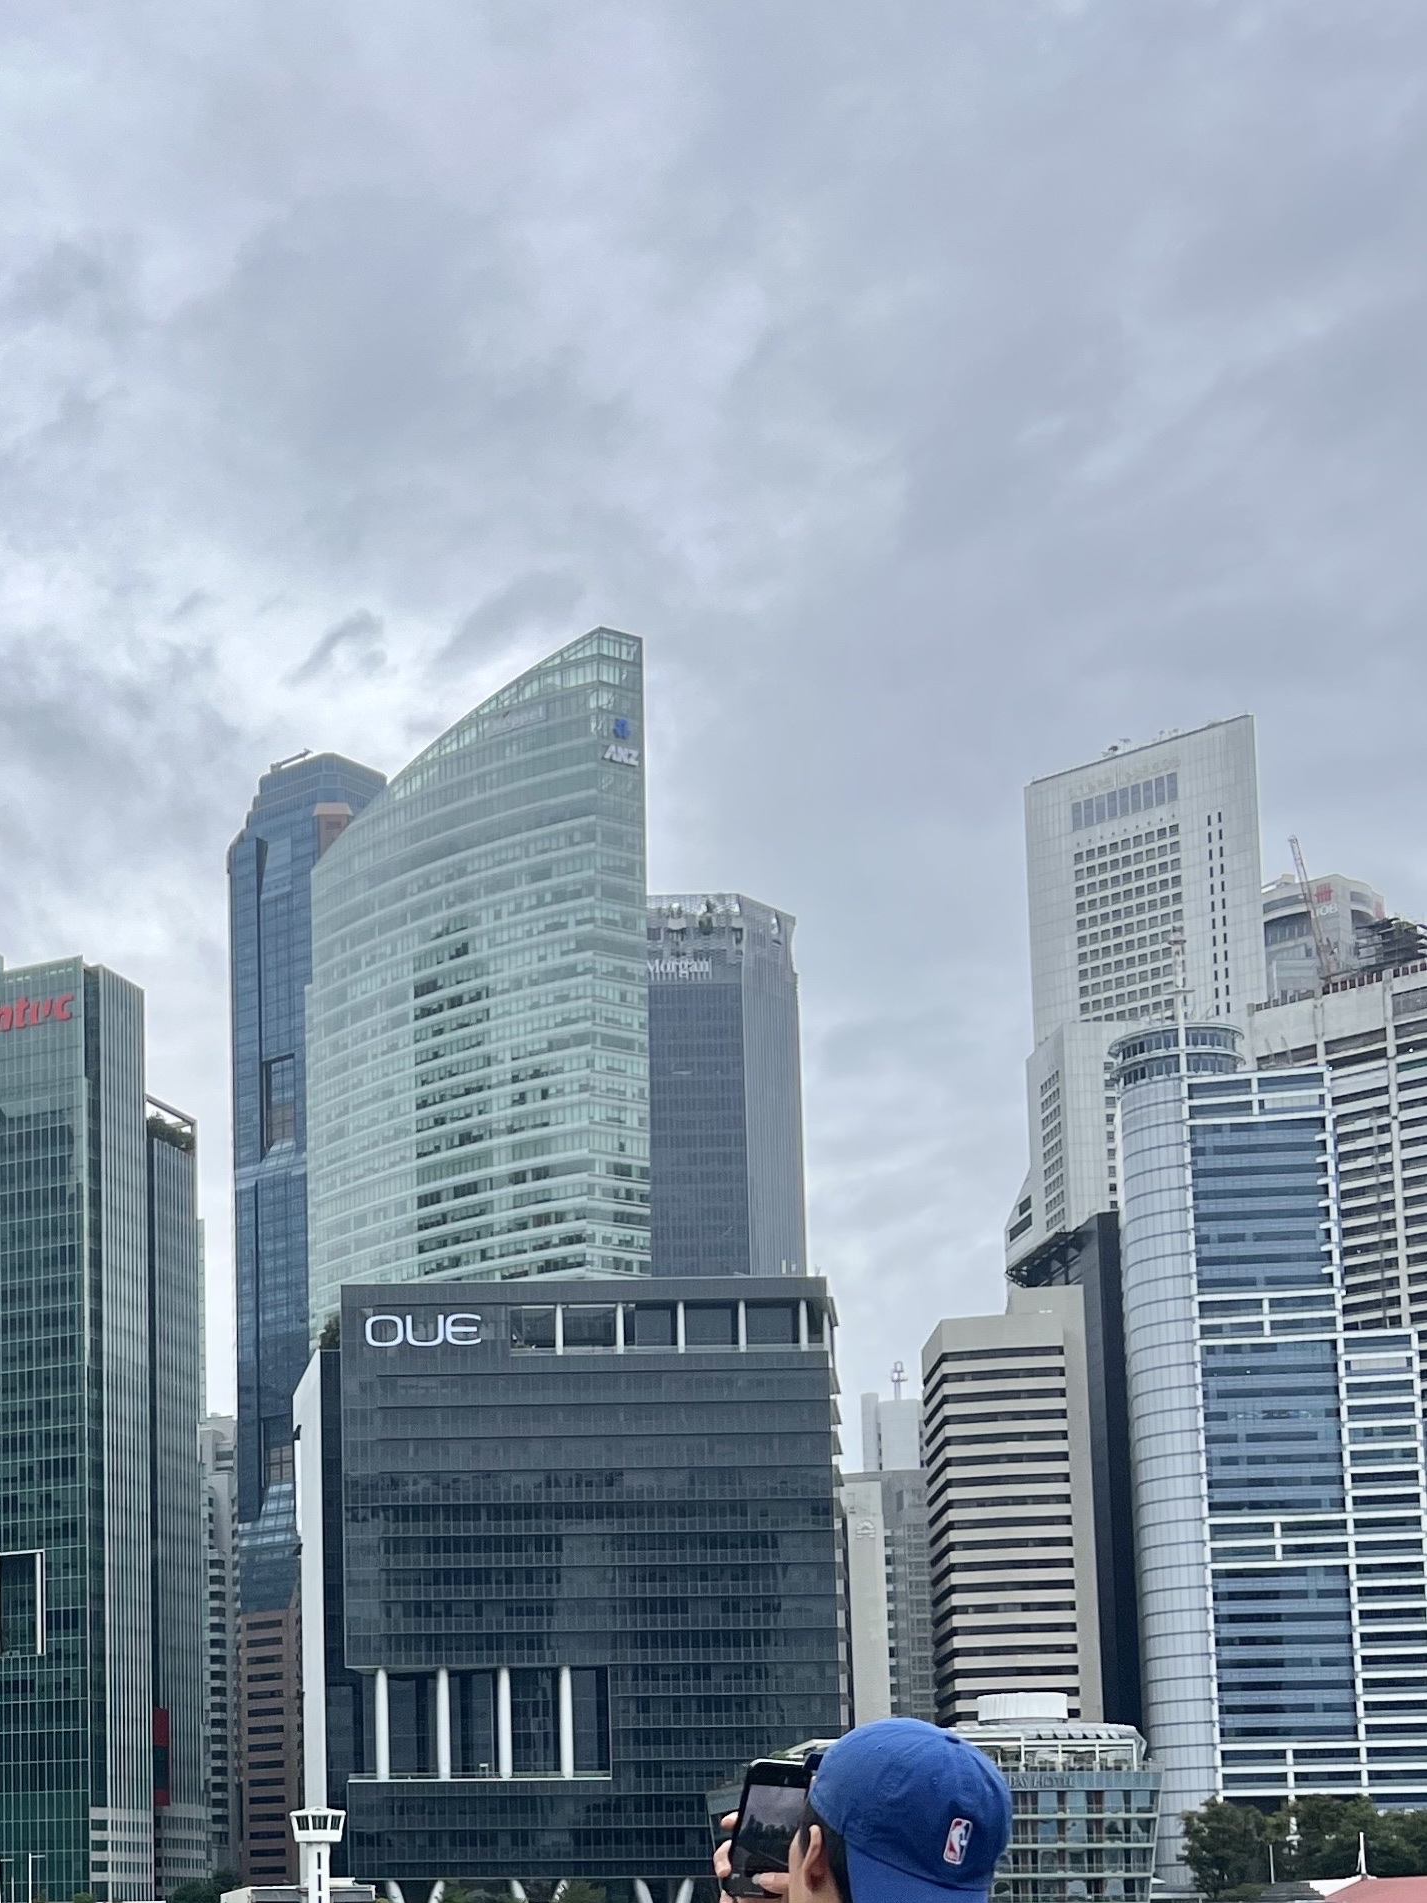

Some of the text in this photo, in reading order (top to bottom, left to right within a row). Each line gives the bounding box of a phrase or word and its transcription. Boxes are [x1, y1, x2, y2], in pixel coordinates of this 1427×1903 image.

[602, 744, 640, 766] ANZ
[647, 958, 710, 979] Morgan
[364, 1313, 482, 1347] OUE
